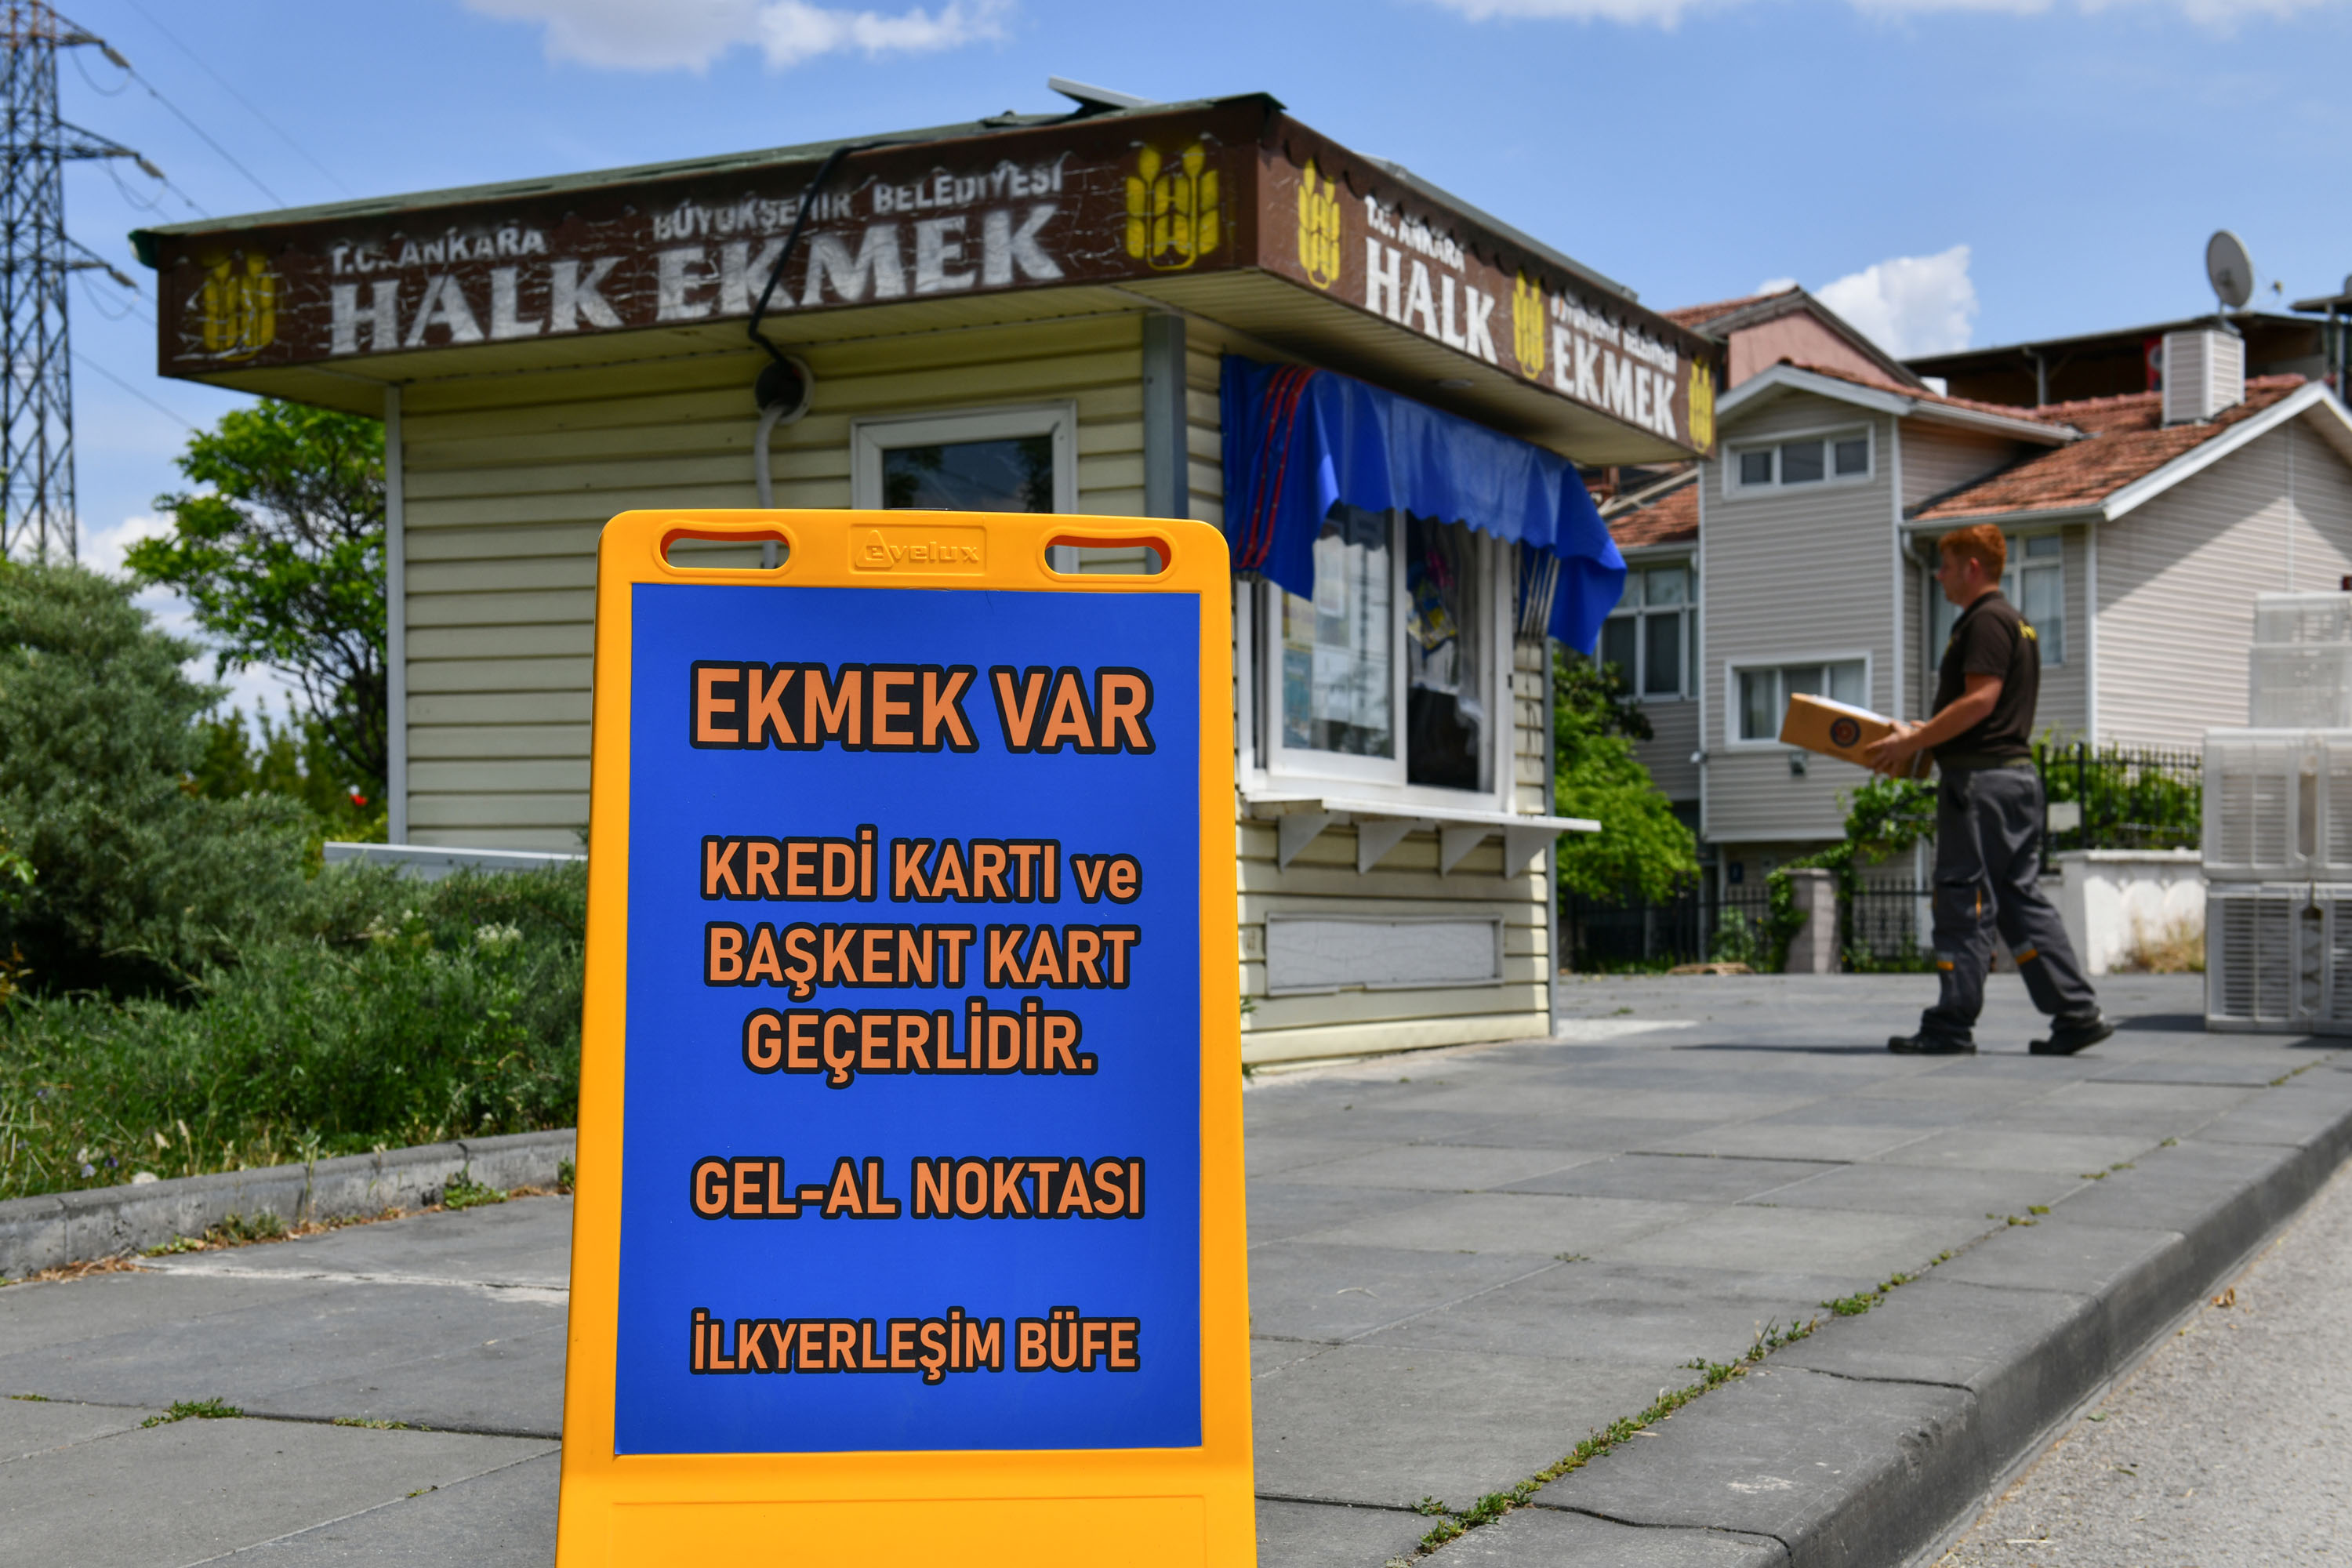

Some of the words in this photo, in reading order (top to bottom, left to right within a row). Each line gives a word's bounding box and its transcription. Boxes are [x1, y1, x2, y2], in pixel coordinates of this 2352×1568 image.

[330, 256, 627, 355] HALK
[655, 204, 1065, 322] EKMEK
[398, 226, 548, 268] ANKARA
[1365, 236, 1498, 365] HALK
[1552, 322, 1678, 441] EKMEK
[691, 661, 978, 753] EKMEK
[989, 666, 1155, 754] VAR
[701, 825, 877, 902] KREDİ
[891, 838, 1060, 902] KARTI
[1070, 854, 1142, 904] ve
[705, 922, 976, 1002] BAŞKENT
[985, 924, 1141, 989] KART
[743, 996, 1098, 1089] GEÇERLİDİR.
[691, 1156, 901, 1219] GEL-AL
[912, 1157, 1145, 1219] NOKTASI
[691, 1307, 1004, 1385] İLKYERLEŞİM
[1016, 1307, 1140, 1372] BÜFE
